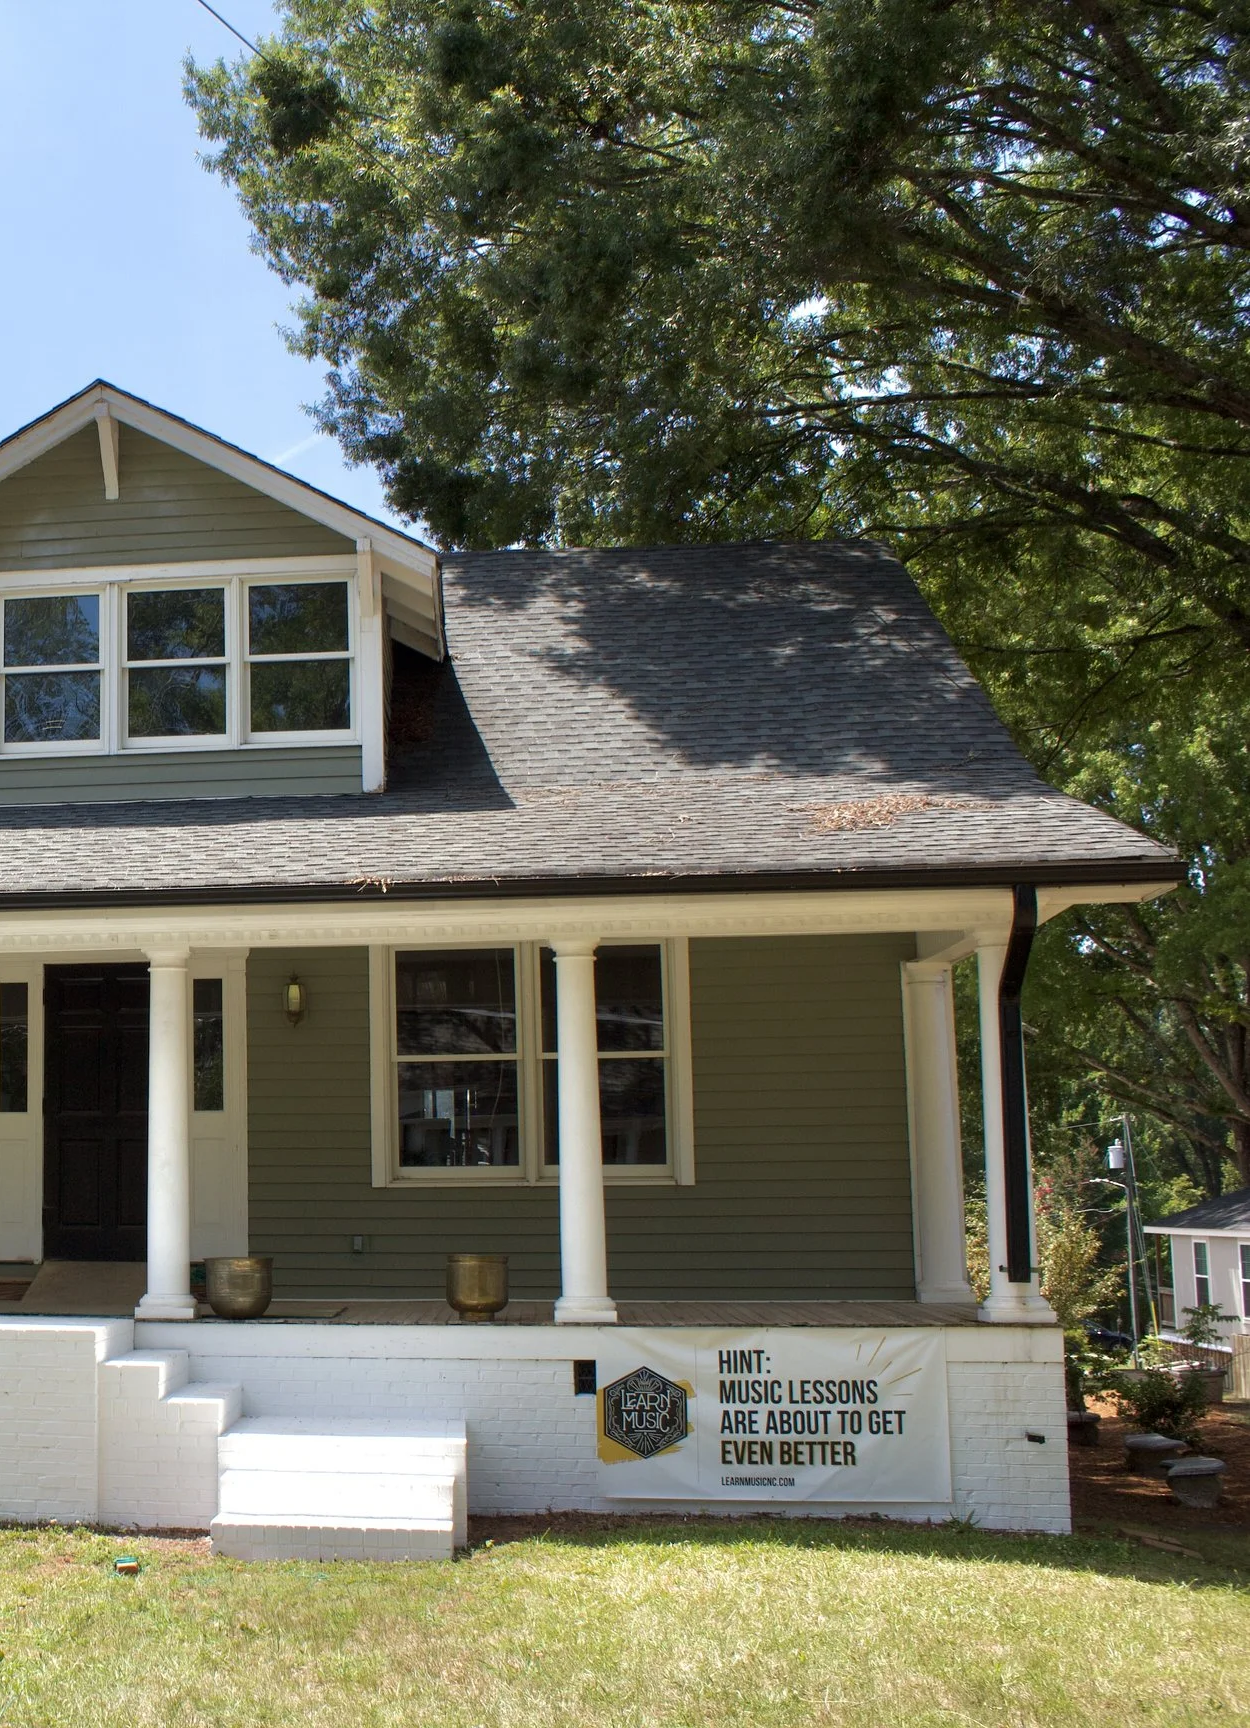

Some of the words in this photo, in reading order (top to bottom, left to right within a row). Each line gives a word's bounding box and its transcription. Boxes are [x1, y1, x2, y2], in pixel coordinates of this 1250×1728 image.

[719, 1349, 771, 1374] HINT:
[621, 1389, 670, 1412] LEARN
[720, 1380, 782, 1404] MUSIC
[789, 1380, 878, 1404] LESSONS
[622, 1410, 670, 1432] MUSIC
[720, 1410, 760, 1434] ARE
[766, 1410, 829, 1435] ABOUT
[837, 1410, 862, 1435] TO
[868, 1410, 906, 1435] GET
[721, 1441, 773, 1465] EVEN
[780, 1441, 856, 1465] BETTER
[721, 1476, 795, 1487] LEARNMUSICNC.COM
